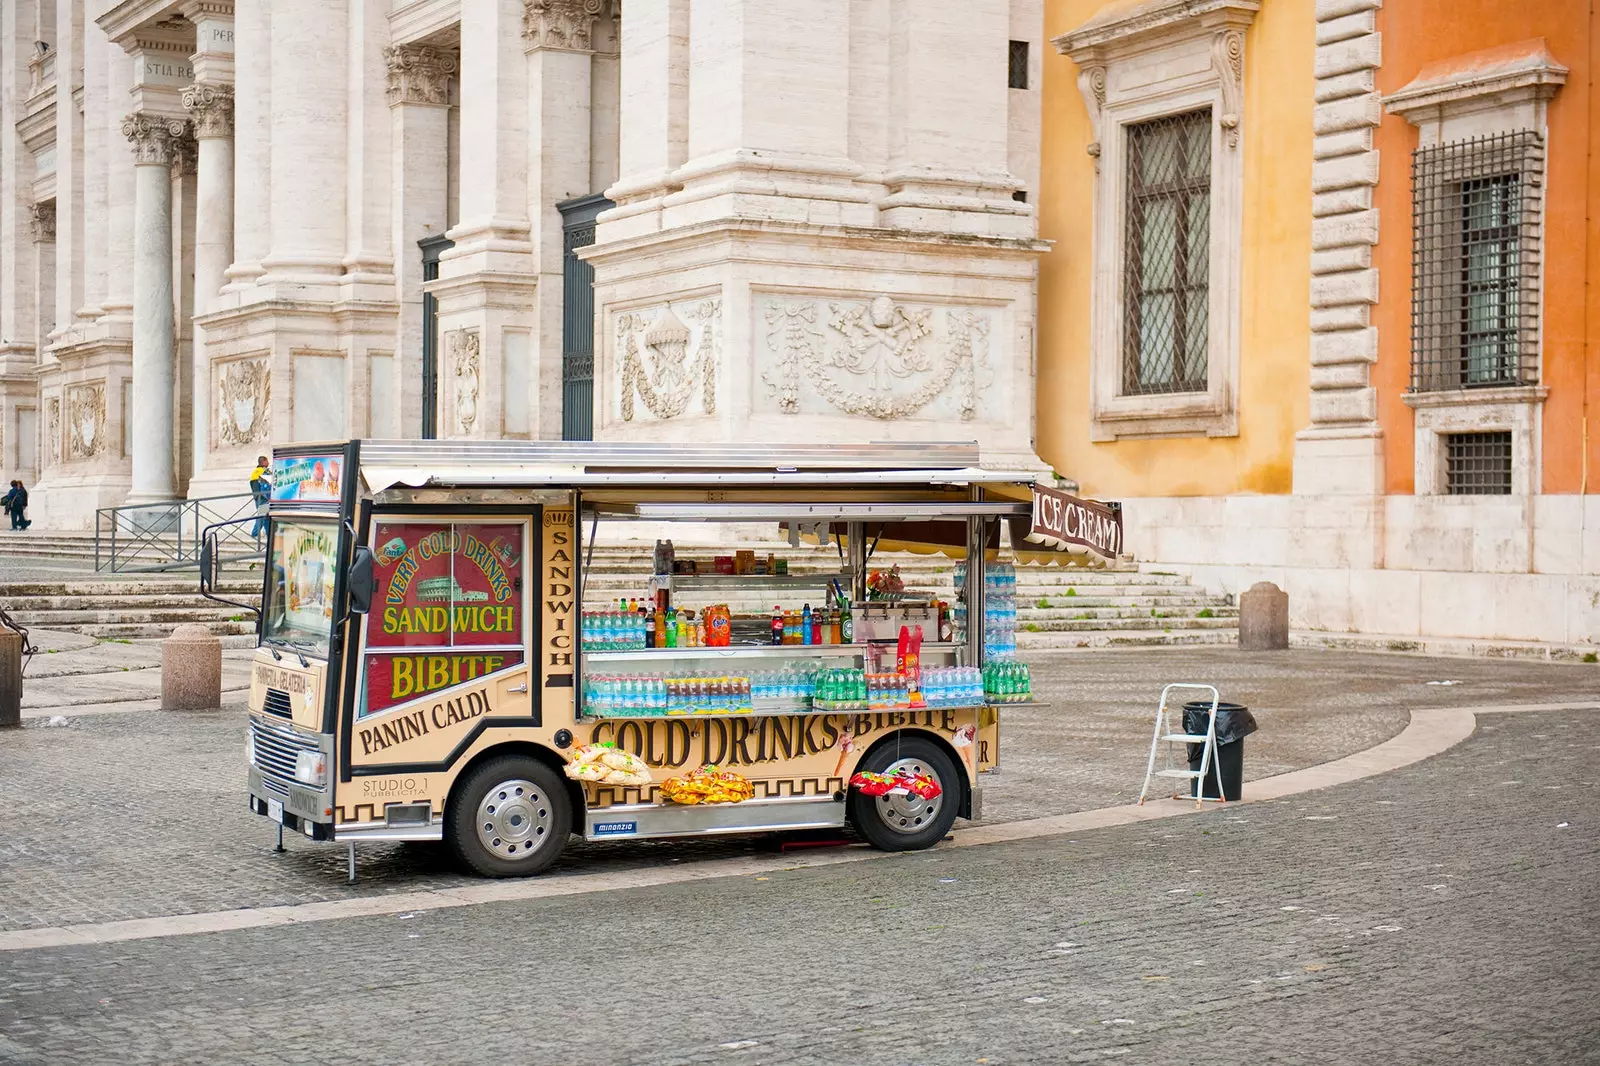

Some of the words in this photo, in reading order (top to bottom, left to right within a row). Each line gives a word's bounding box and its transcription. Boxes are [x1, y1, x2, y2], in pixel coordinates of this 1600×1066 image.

[1033, 492, 1062, 533] ICE
[1065, 503, 1117, 552] CREAM
[386, 548, 420, 604] VERY
[418, 531, 461, 560] COLD
[463, 534, 512, 605] DRINKS
[383, 606, 514, 634] SANDWICH
[546, 531, 574, 665] SANDWICH
[391, 655, 504, 700] BIBITE
[359, 710, 430, 756] PANINI
[431, 688, 492, 730] CALDI
[591, 718, 692, 768] COLD
[702, 714, 839, 767] DRINKS
[852, 709, 960, 739] BIBITE
[363, 778, 416, 792] STUDIO
[423, 778, 429, 789] 1
